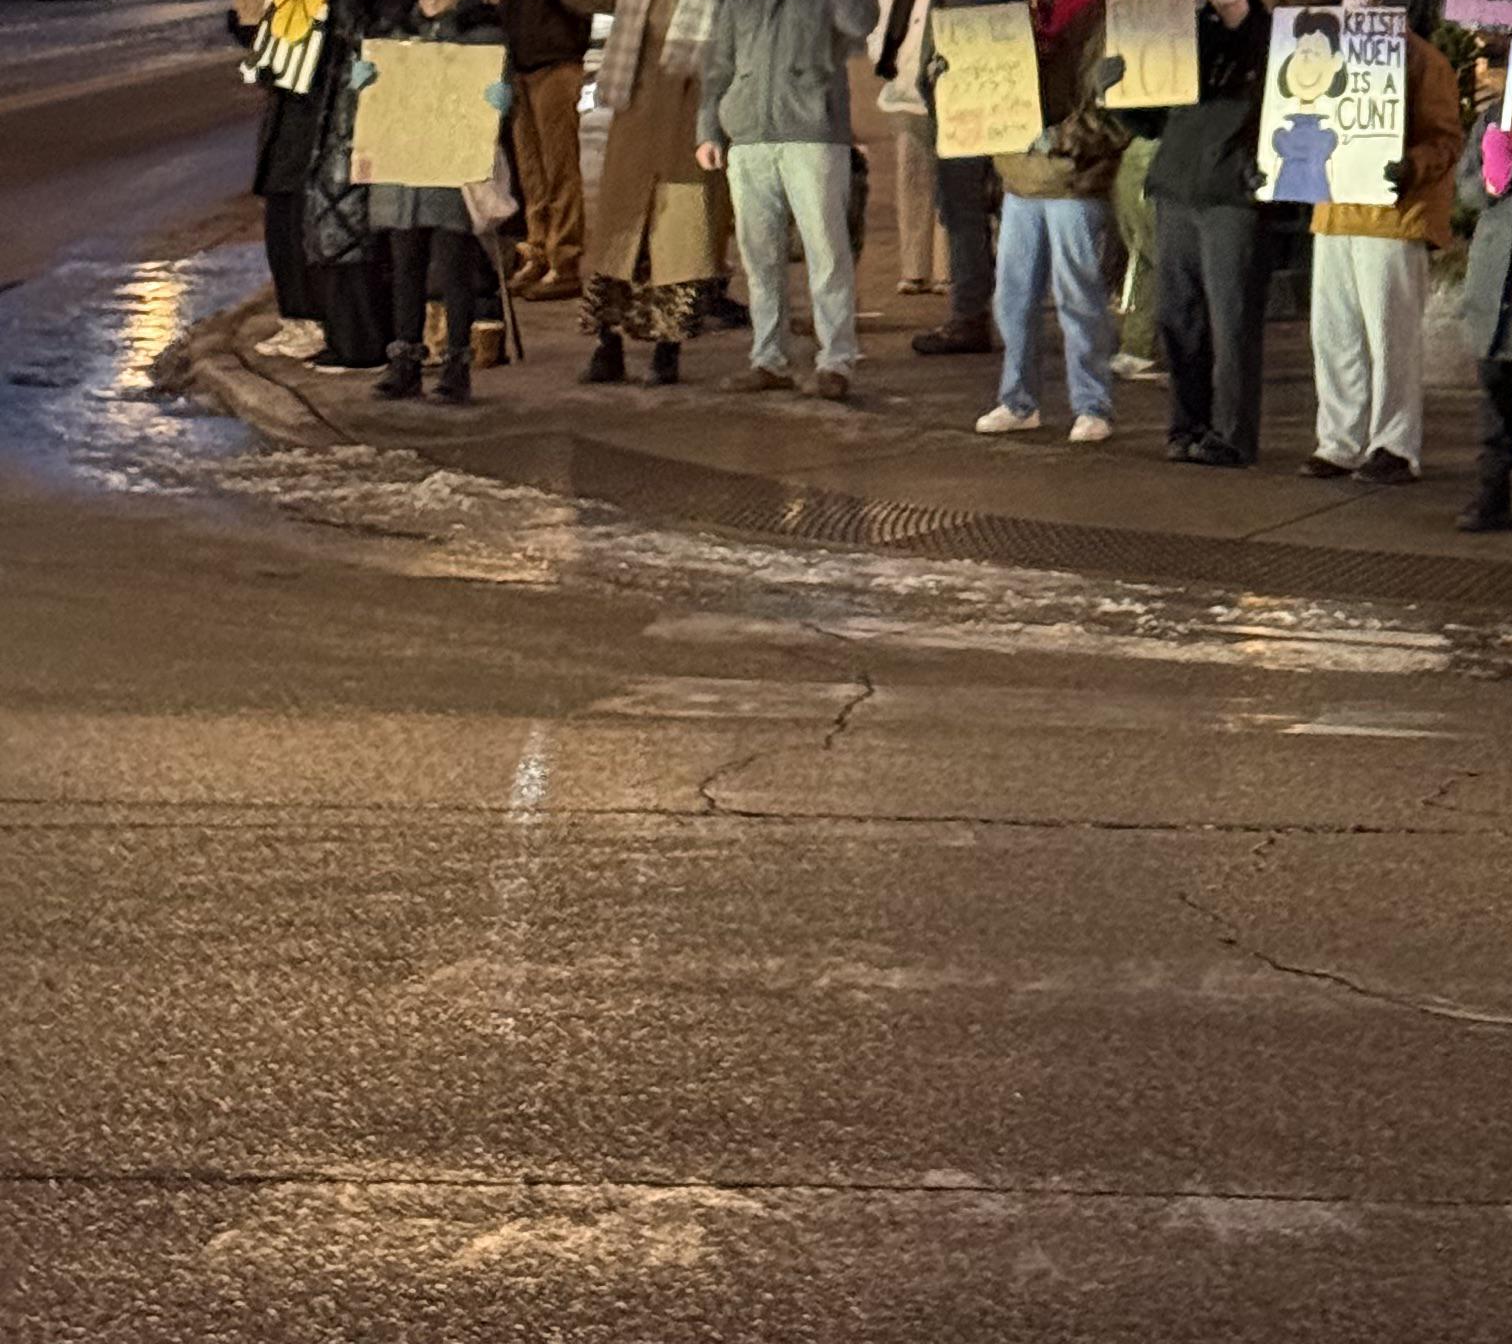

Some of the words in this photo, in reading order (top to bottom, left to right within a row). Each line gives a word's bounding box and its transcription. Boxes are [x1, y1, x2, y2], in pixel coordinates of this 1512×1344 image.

[1347, 37, 1401, 68] NOEM
[1350, 71, 1371, 94] IS
[1383, 72, 1397, 94] A
[1338, 97, 1400, 131] CUNT
